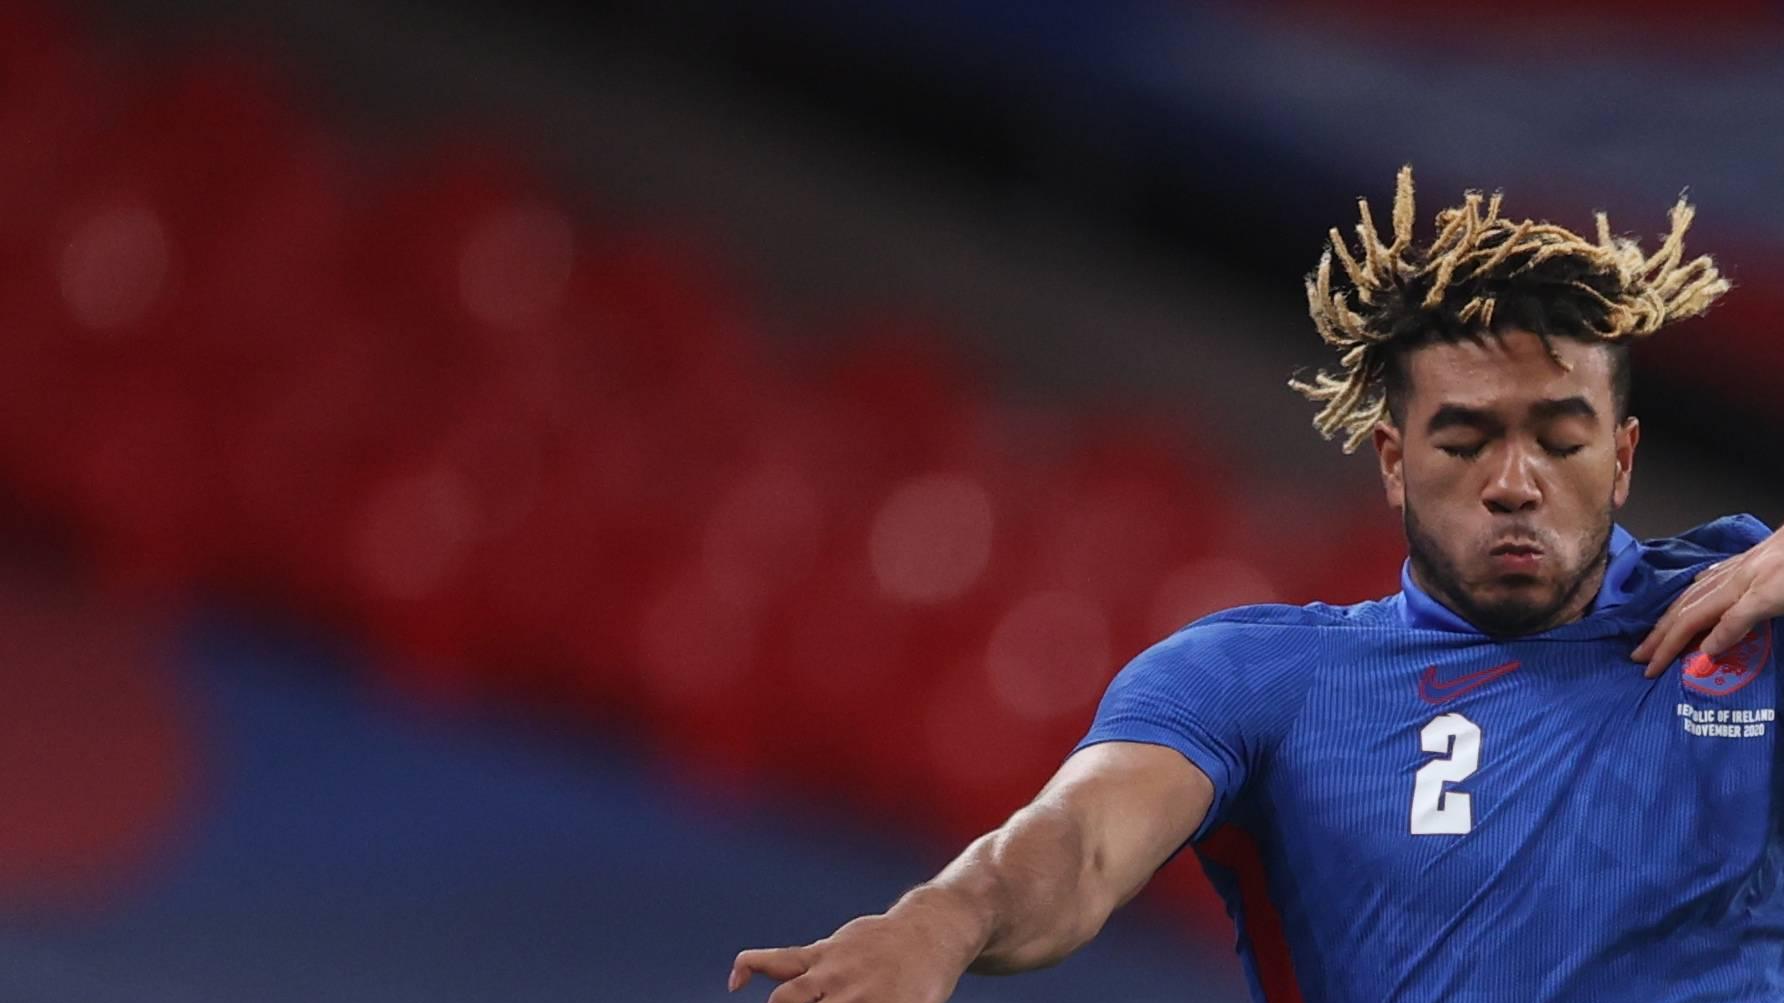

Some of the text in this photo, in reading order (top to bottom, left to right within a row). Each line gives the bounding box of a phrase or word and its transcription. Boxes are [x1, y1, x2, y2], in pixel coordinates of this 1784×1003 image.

[1717, 709, 1731, 723] OF
[1732, 708, 1775, 723] IRELAND
[1743, 723, 1765, 738] 2020
[1410, 713, 1482, 835] 2
